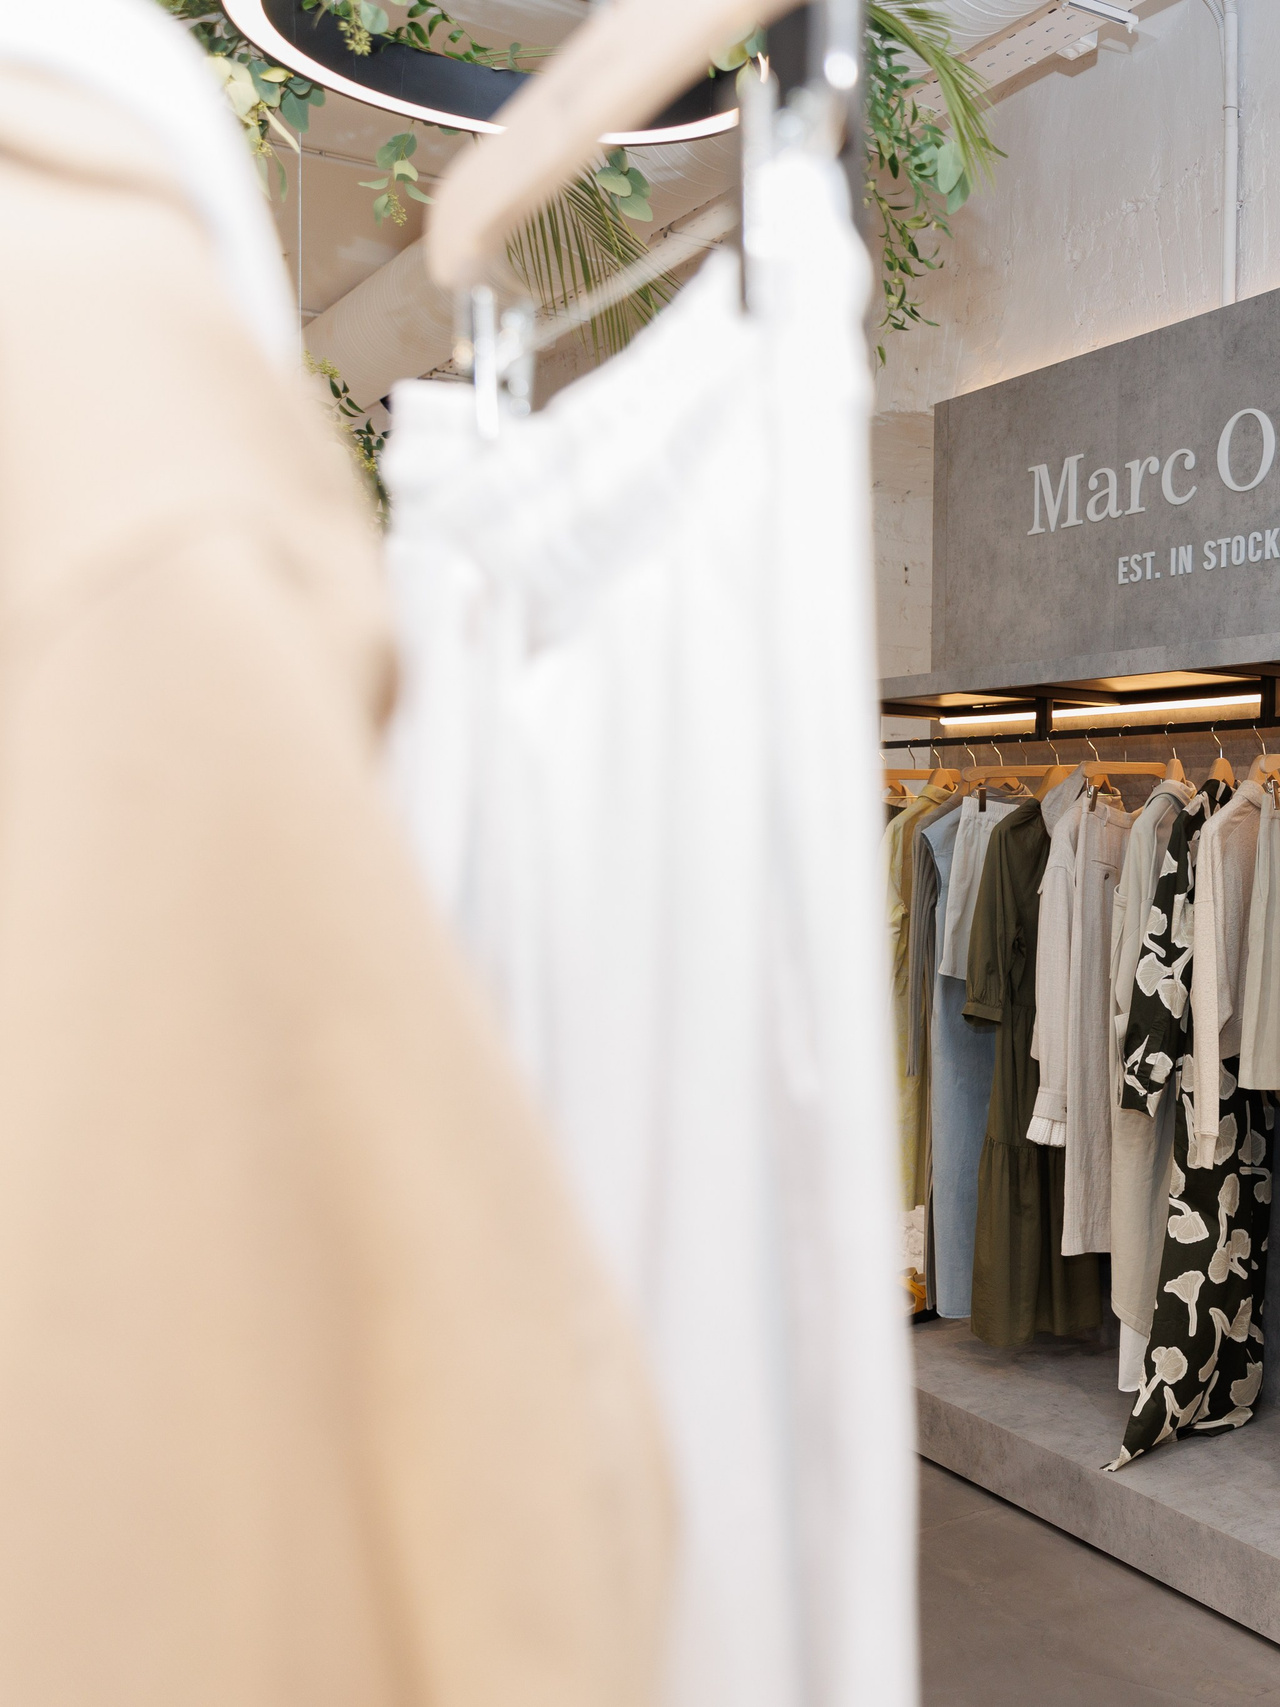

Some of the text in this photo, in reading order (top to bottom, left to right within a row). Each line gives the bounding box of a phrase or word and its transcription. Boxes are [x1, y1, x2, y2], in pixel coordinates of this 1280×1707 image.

[1027, 448, 1198, 536] Marc
[1117, 551, 1161, 585] EST.
[1170, 543, 1193, 577] IN
